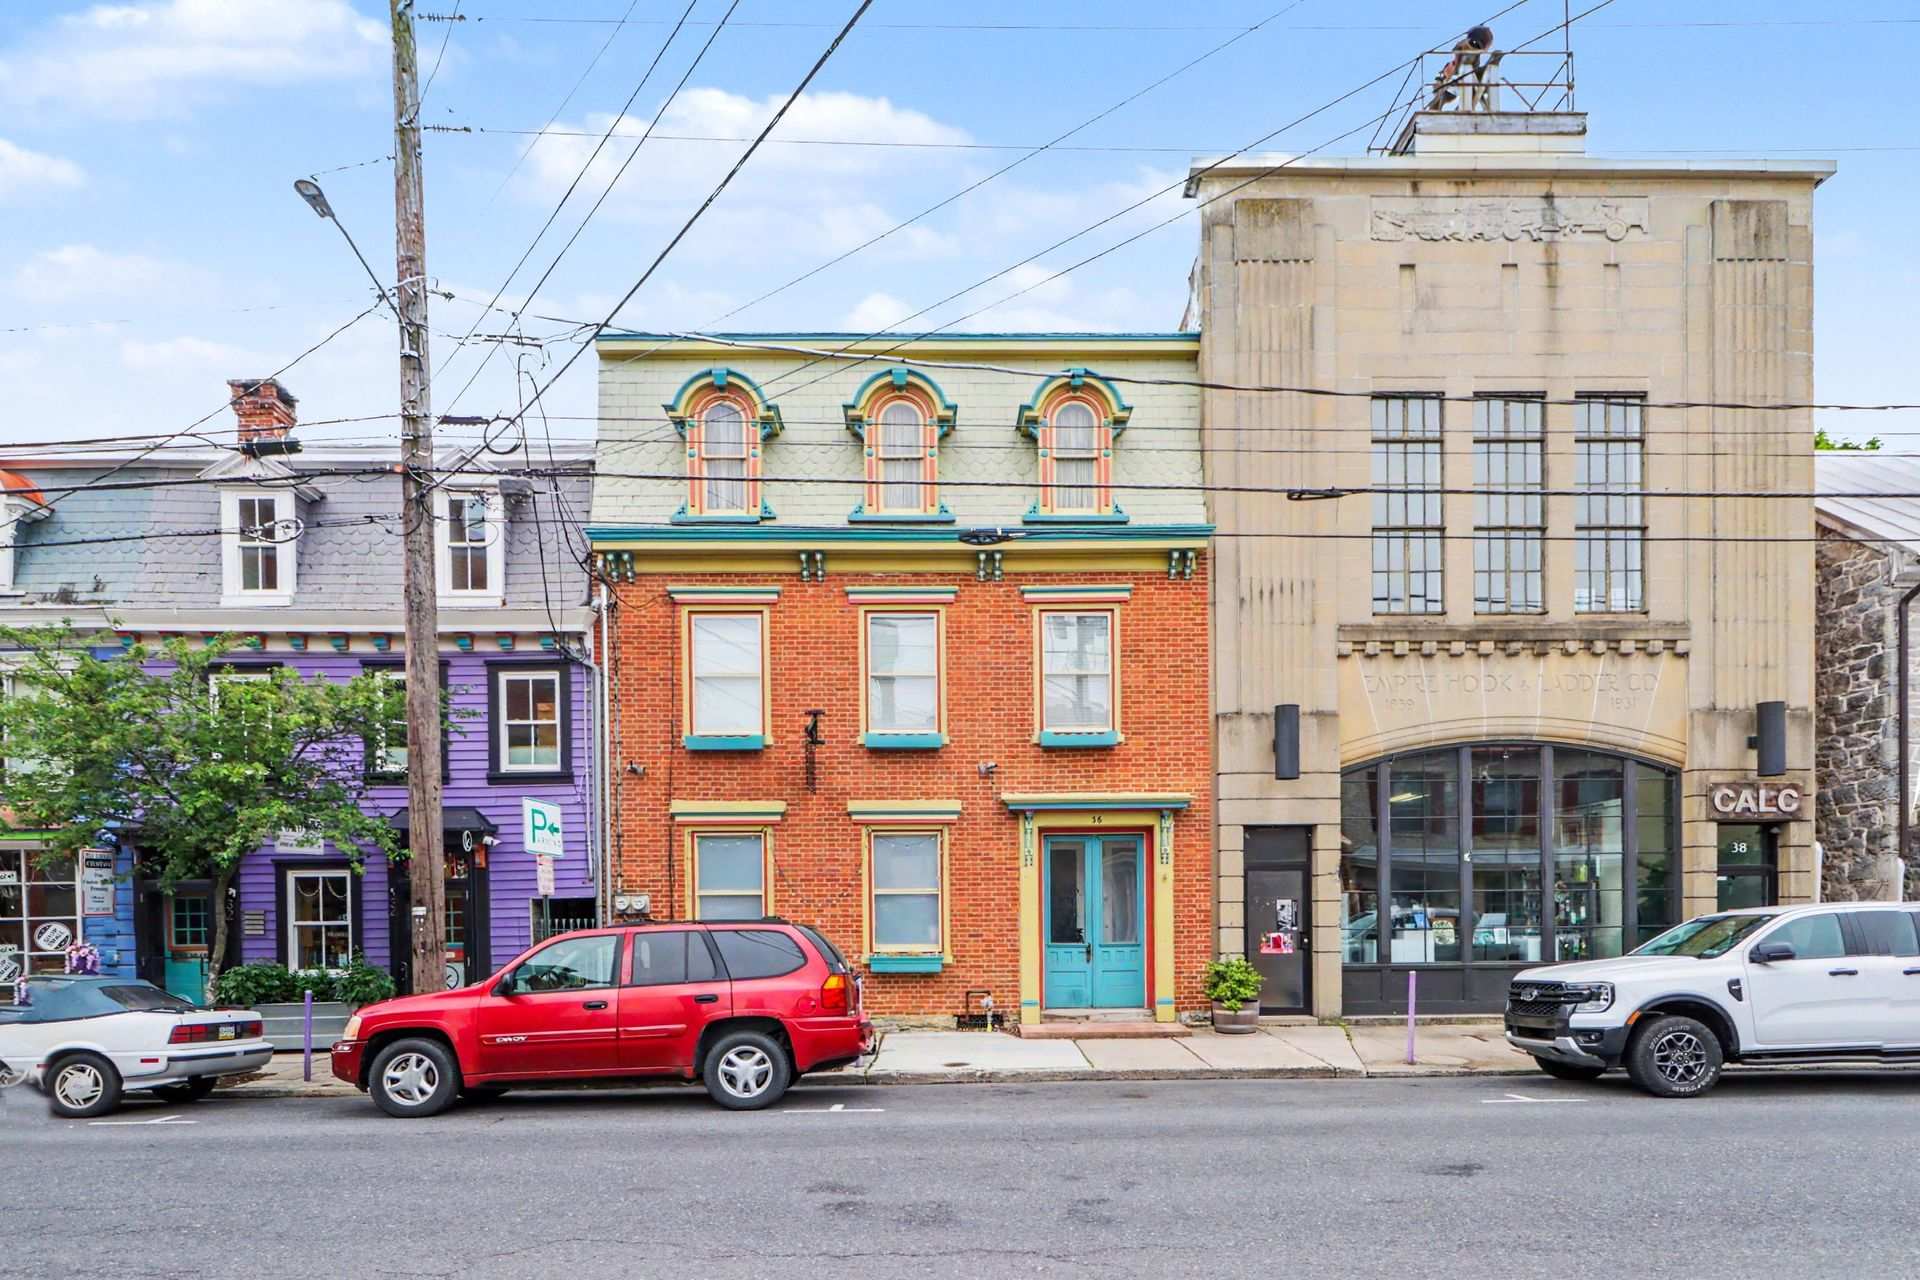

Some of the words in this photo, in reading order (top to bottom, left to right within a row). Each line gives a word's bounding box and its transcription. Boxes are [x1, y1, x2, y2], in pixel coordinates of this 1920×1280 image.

[1445, 673, 1513, 693] HOOK
[1538, 673, 1620, 693] LADDER
[1713, 788, 1800, 813] CALC
[531, 808, 547, 843] P
[1731, 842, 1748, 853] 38
